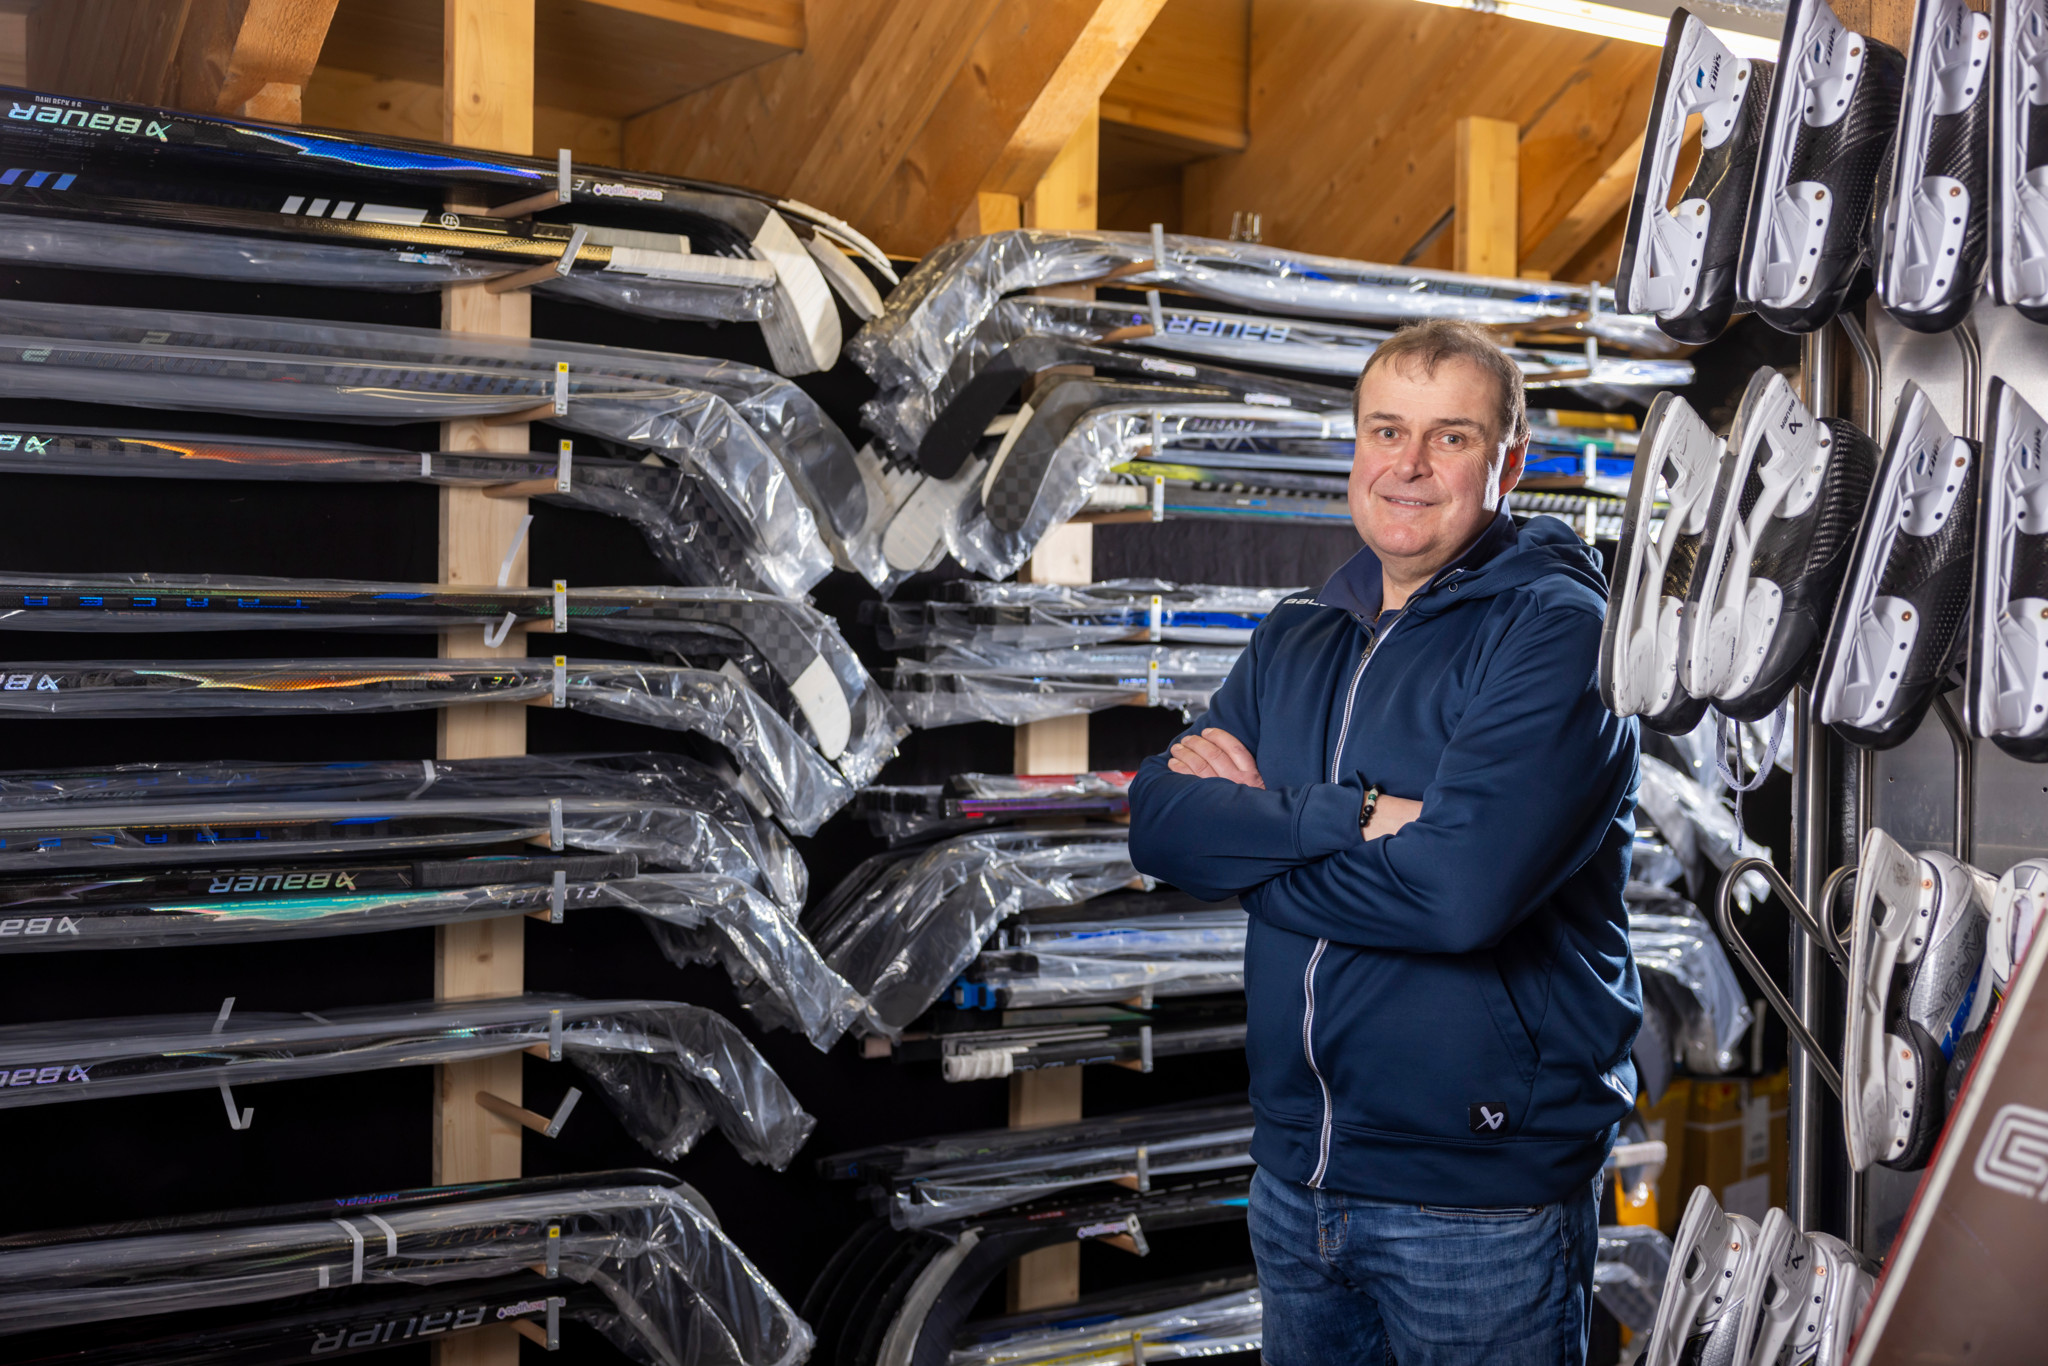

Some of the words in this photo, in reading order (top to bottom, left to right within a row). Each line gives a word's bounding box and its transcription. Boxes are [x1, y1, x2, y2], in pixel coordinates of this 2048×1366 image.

[1826, 26, 1837, 69] SHIFT
[1710, 52, 1722, 93] SHIFT
[8, 102, 143, 134] BAUER
[1780, 399, 1796, 430] BAUER
[208, 872, 329, 894] BAUER
[1783, 1233, 1797, 1268] BAUER
